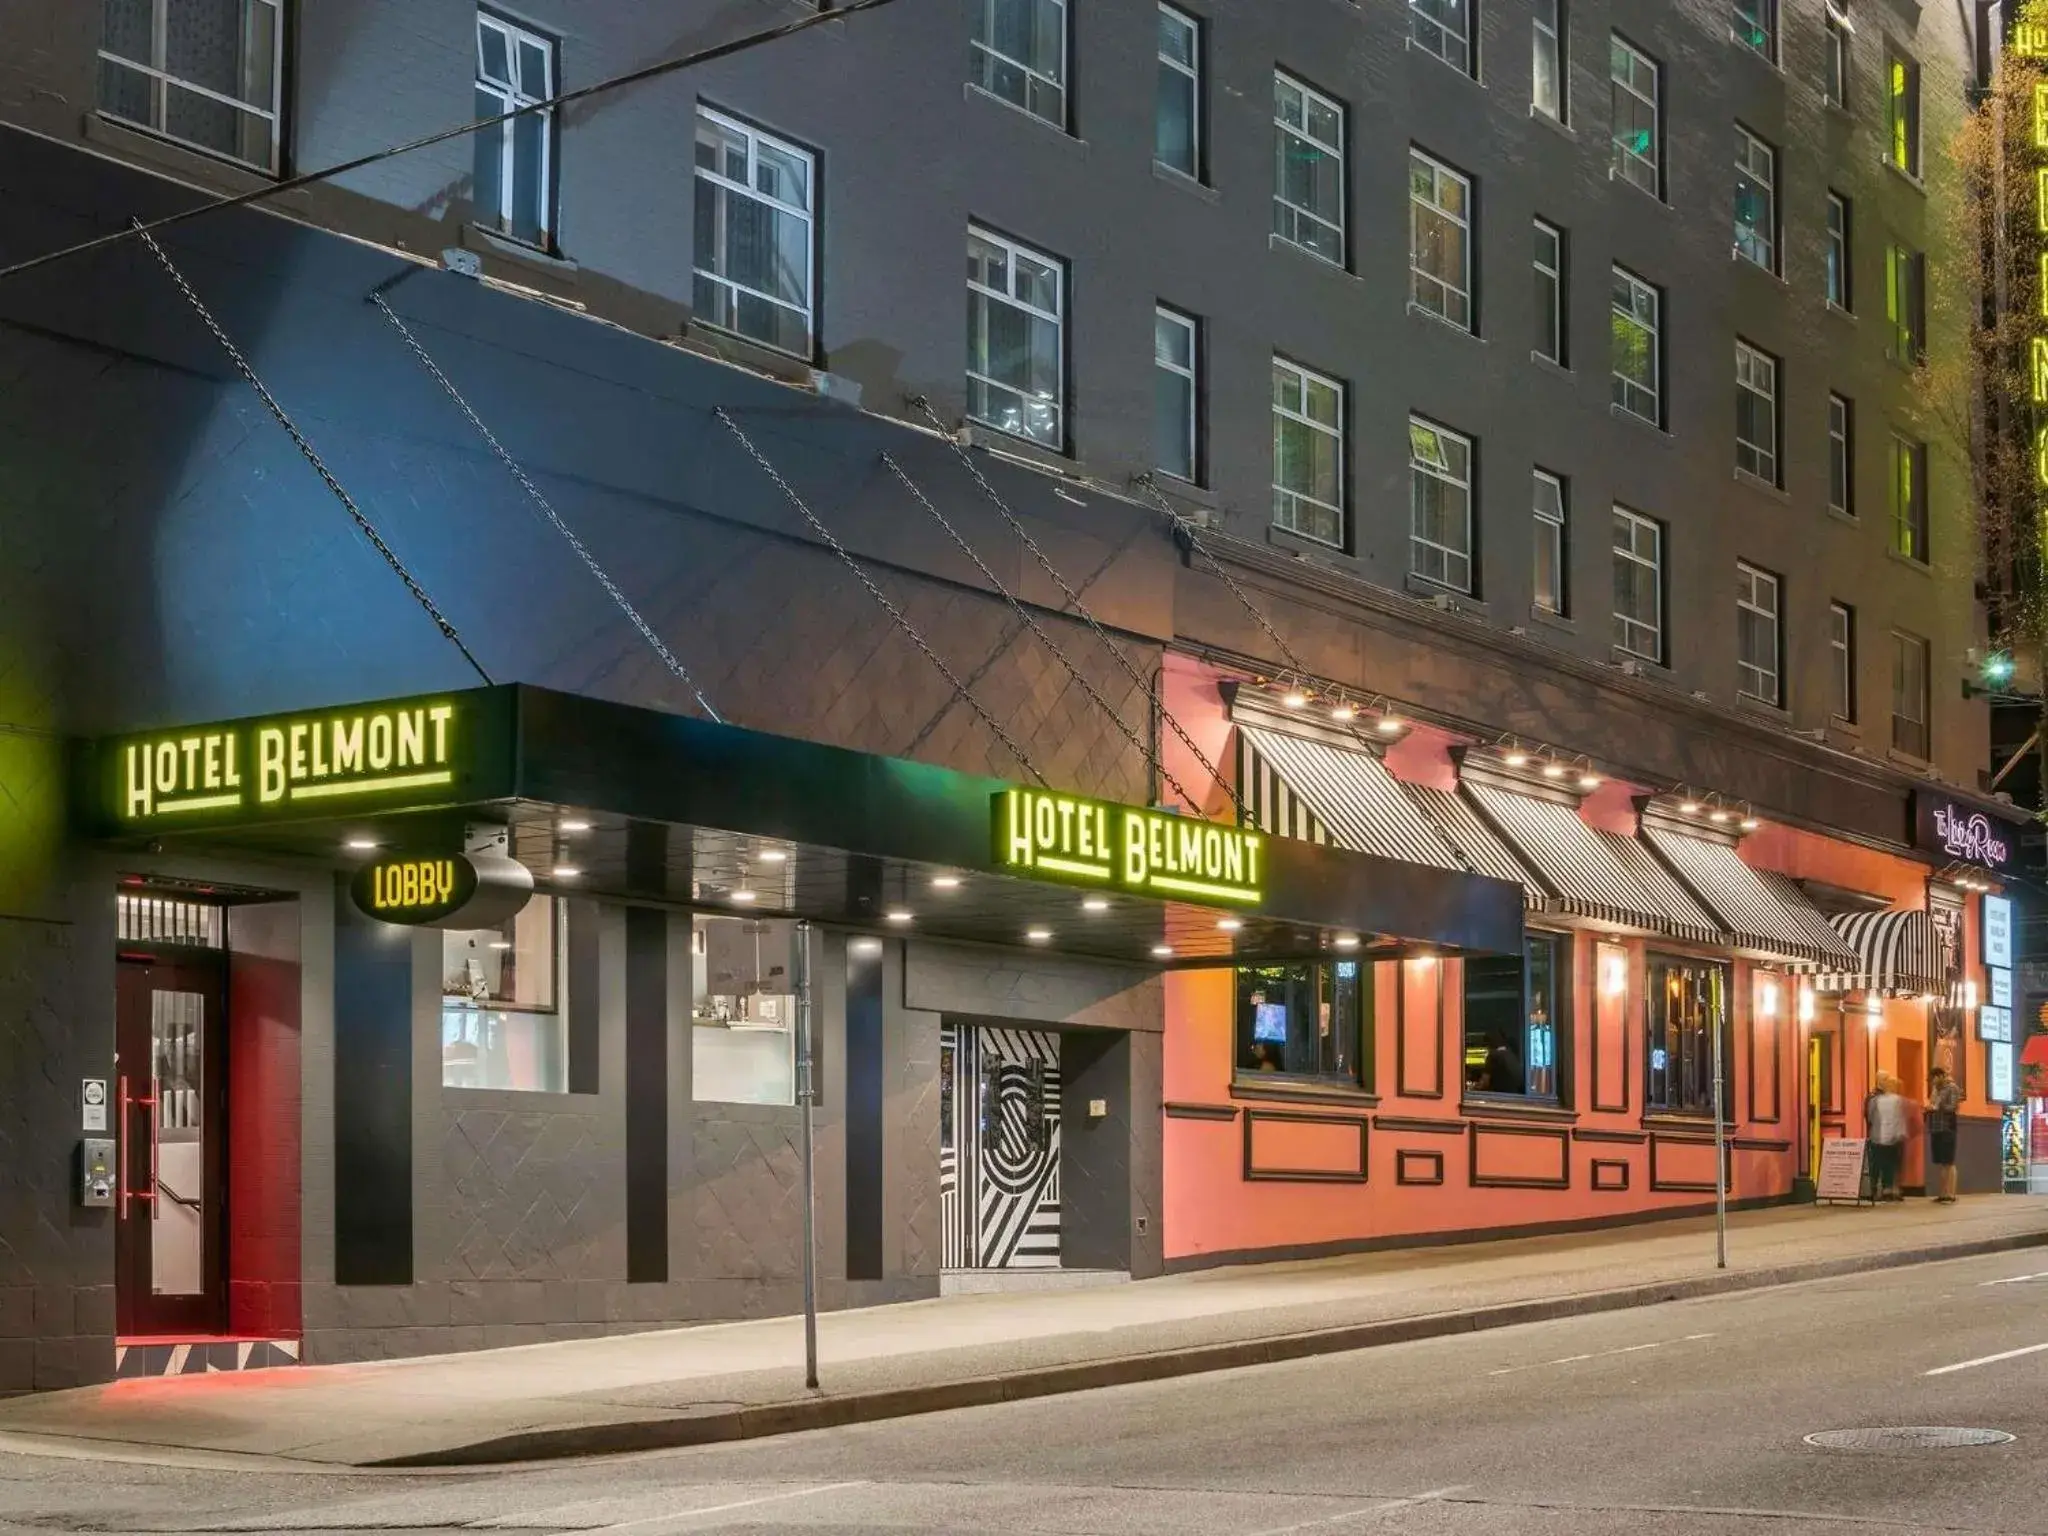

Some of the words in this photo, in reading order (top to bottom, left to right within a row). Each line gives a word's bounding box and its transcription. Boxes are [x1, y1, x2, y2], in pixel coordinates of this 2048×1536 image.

[126, 732, 241, 818] HOTEL
[259, 705, 452, 804] BELMONT
[373, 859, 455, 909] LOBBY
[1008, 789, 1112, 867] HOTEL
[1124, 811, 1261, 885] BELMONT
